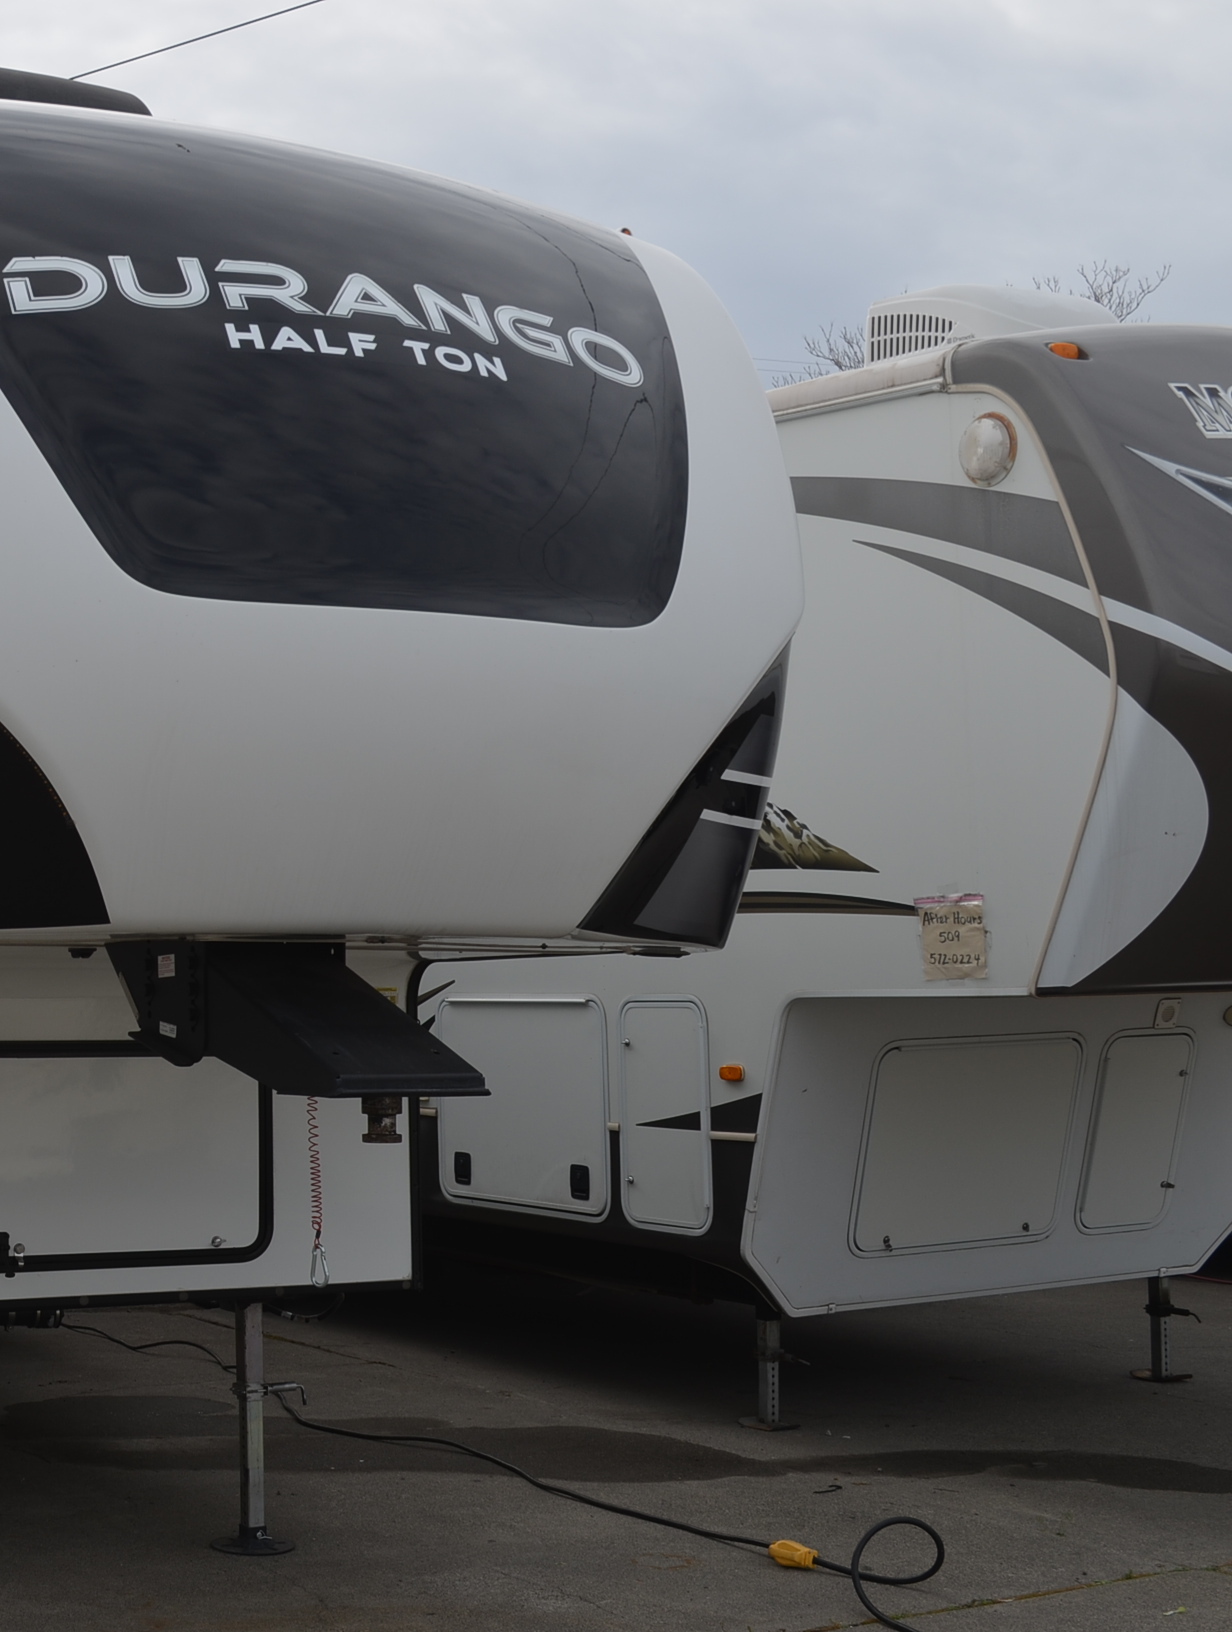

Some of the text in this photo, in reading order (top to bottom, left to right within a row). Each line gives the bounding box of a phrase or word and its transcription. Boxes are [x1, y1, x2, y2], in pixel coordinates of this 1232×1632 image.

[2, 256, 644, 387] DURANGO
[224, 323, 508, 383] HALF TON
[938, 930, 961, 943] 509
[953, 911, 983, 925] Hours
